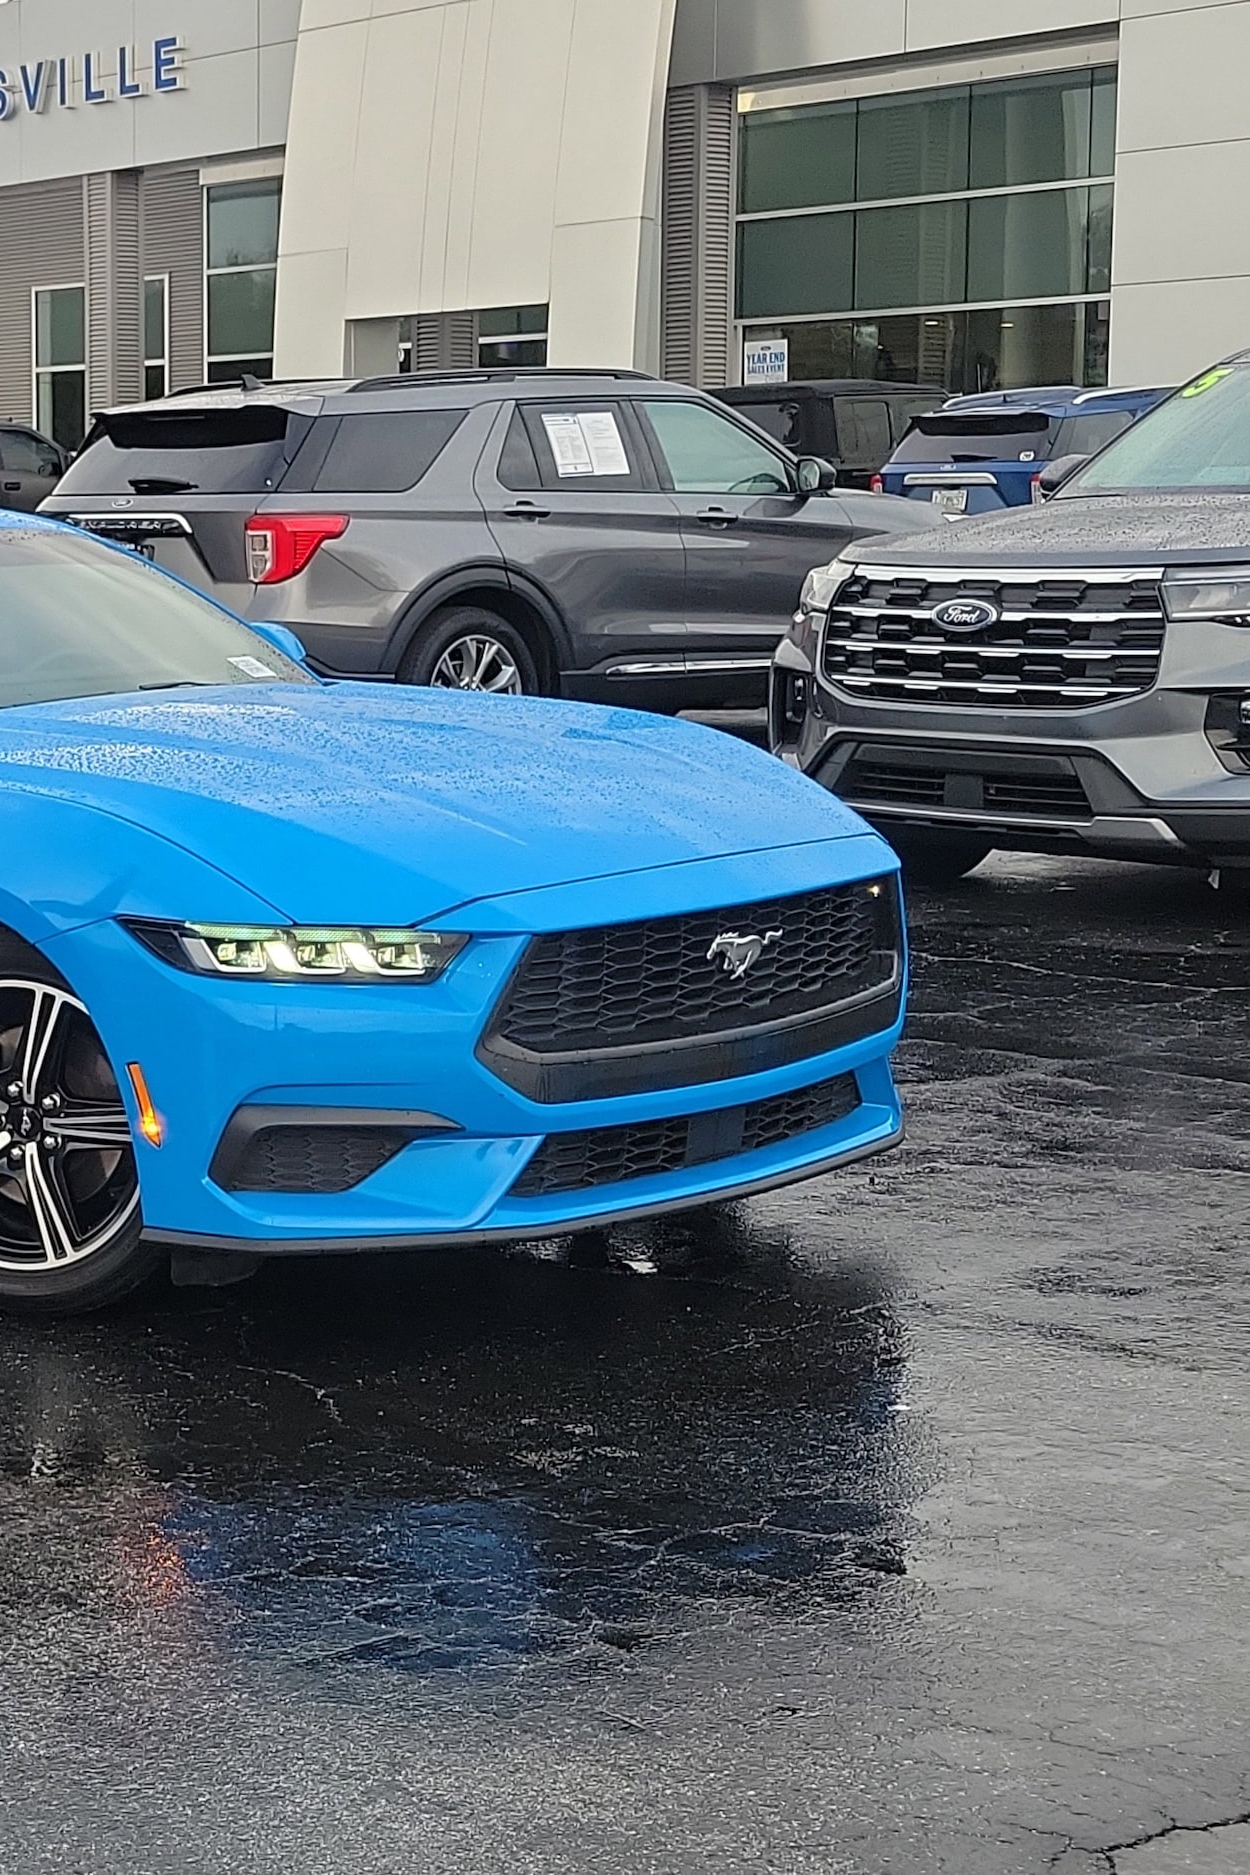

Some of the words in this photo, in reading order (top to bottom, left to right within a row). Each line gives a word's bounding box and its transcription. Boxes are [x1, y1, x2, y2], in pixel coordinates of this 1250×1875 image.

[746, 353, 768, 365] YEAR
[769, 352, 786, 363] END
[1181, 368, 1235, 398] 5
[943, 605, 981, 623] Ford
